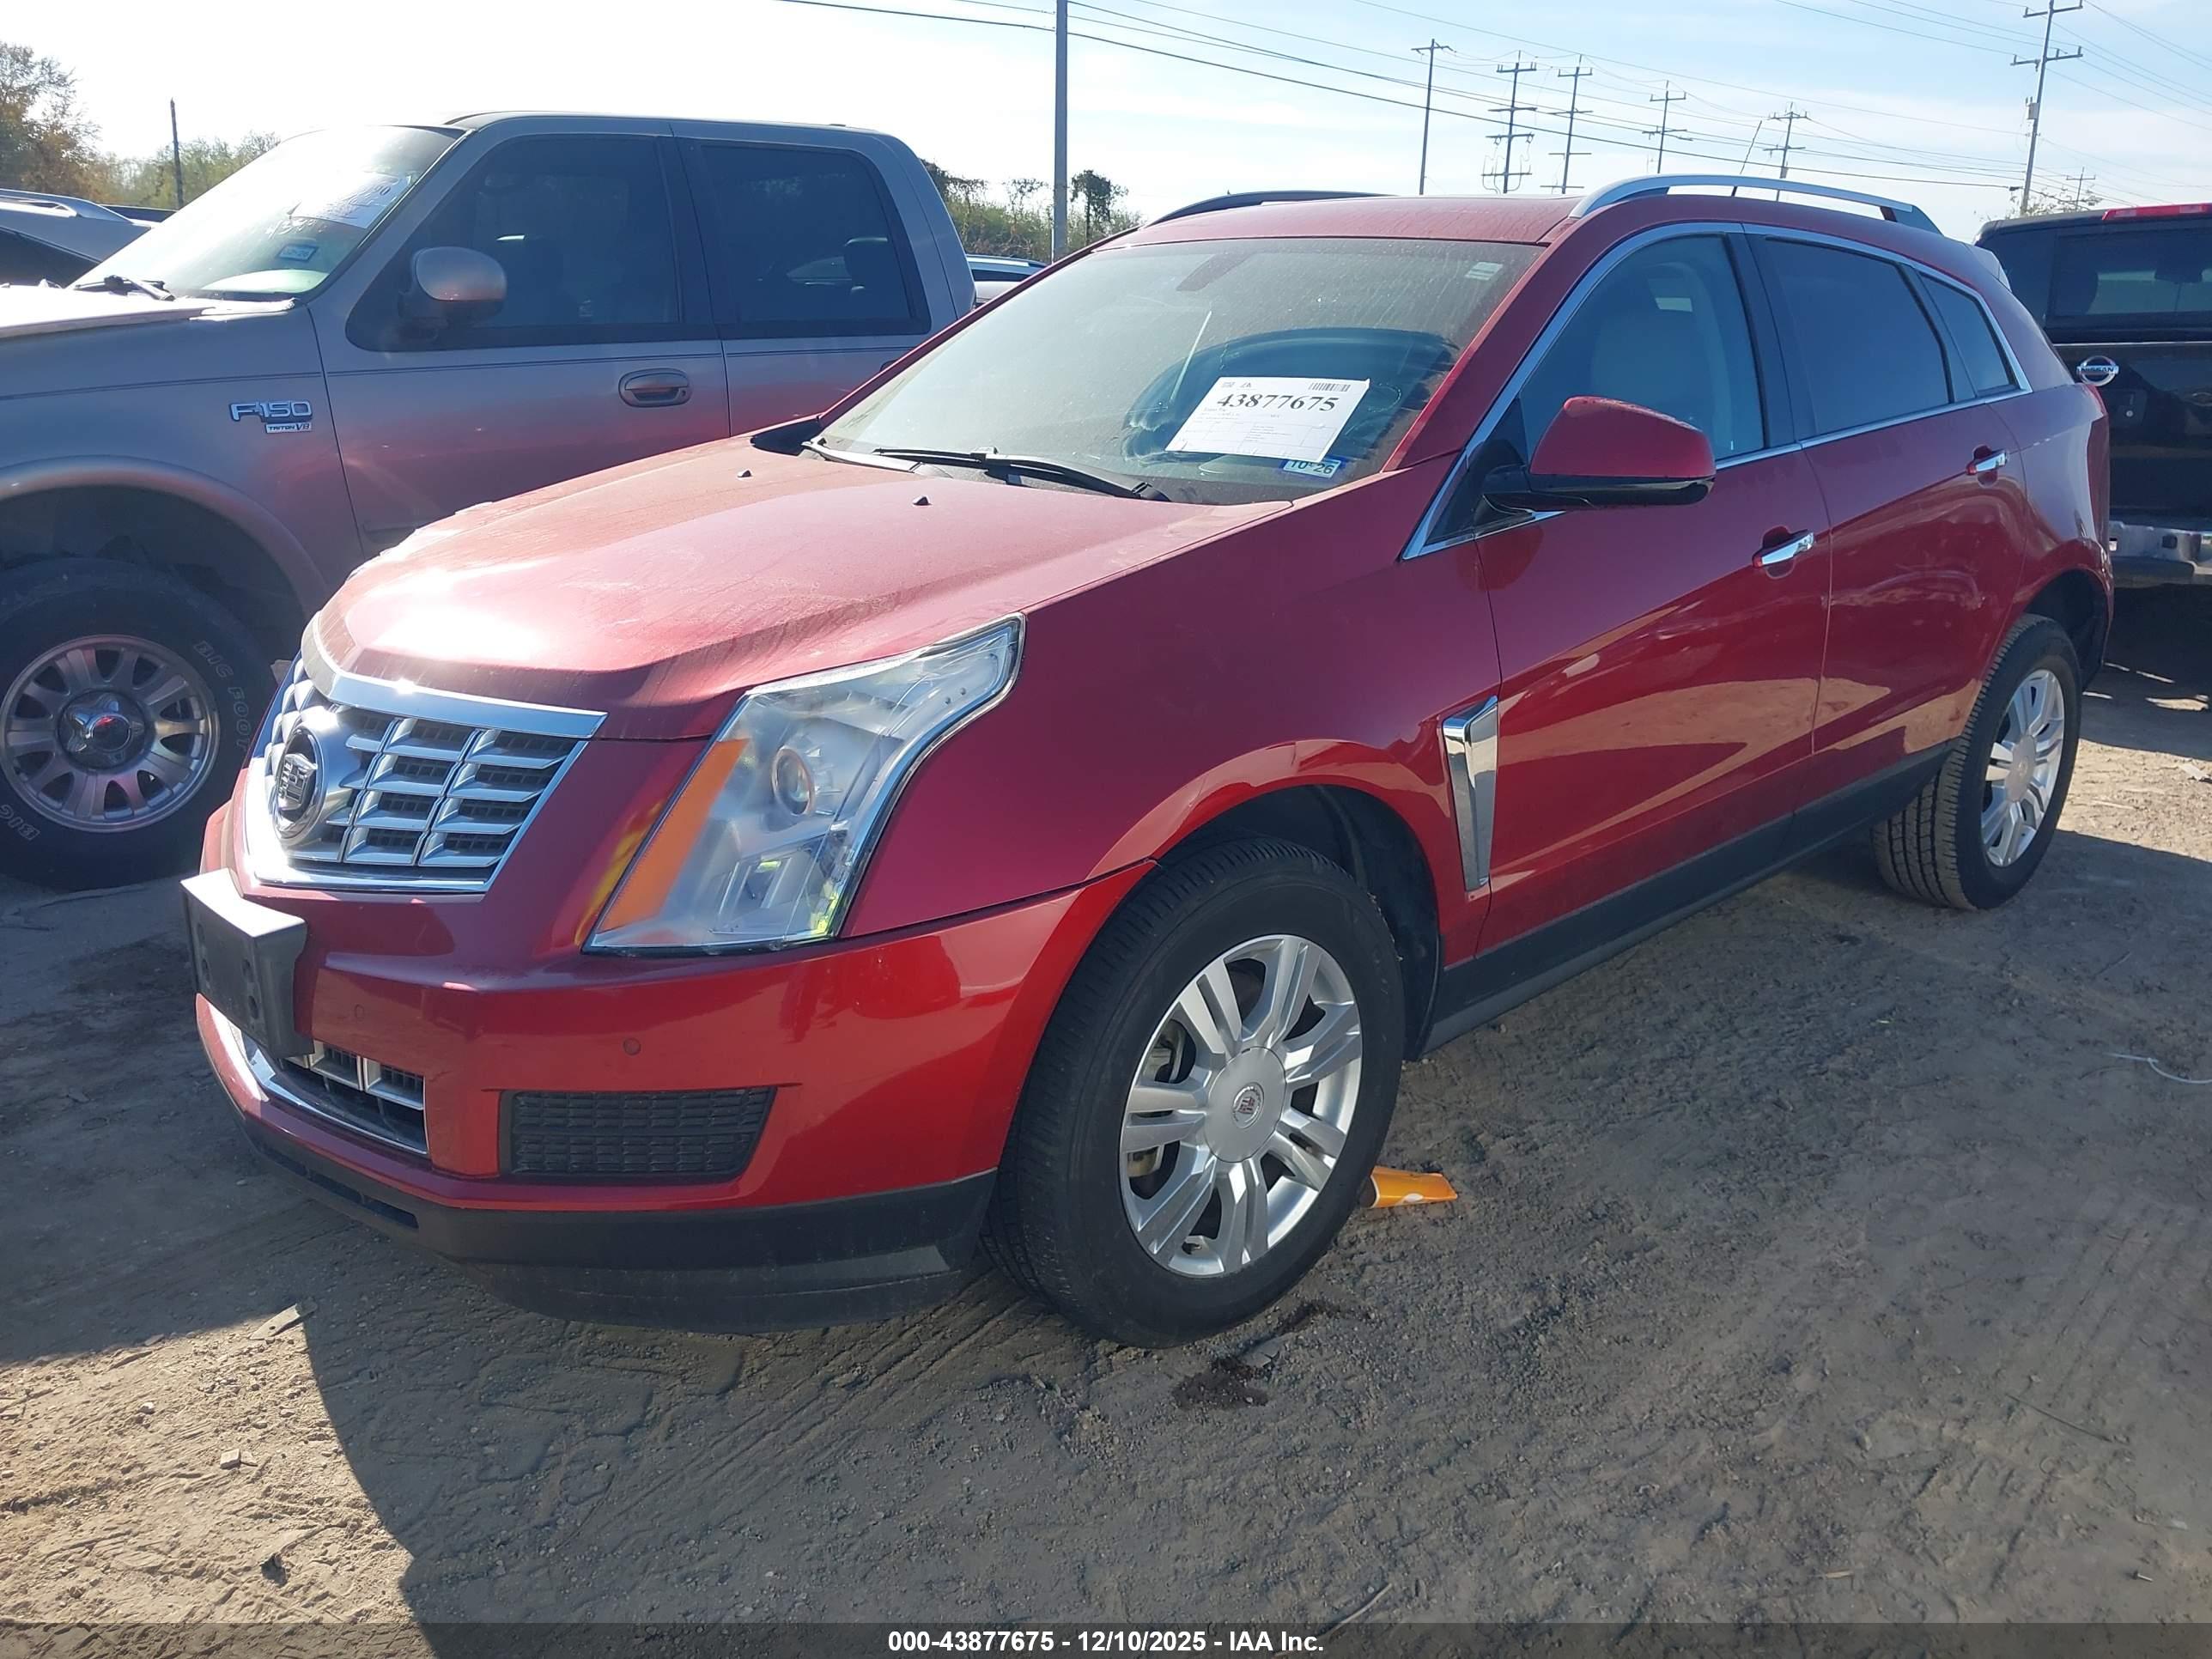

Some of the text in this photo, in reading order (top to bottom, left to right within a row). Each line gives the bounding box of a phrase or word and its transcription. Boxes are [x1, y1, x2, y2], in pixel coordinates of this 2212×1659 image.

[1217, 393, 1340, 412] 43877675
[193, 640, 252, 753] BIG FOOT
[0, 804, 40, 842] BIG
